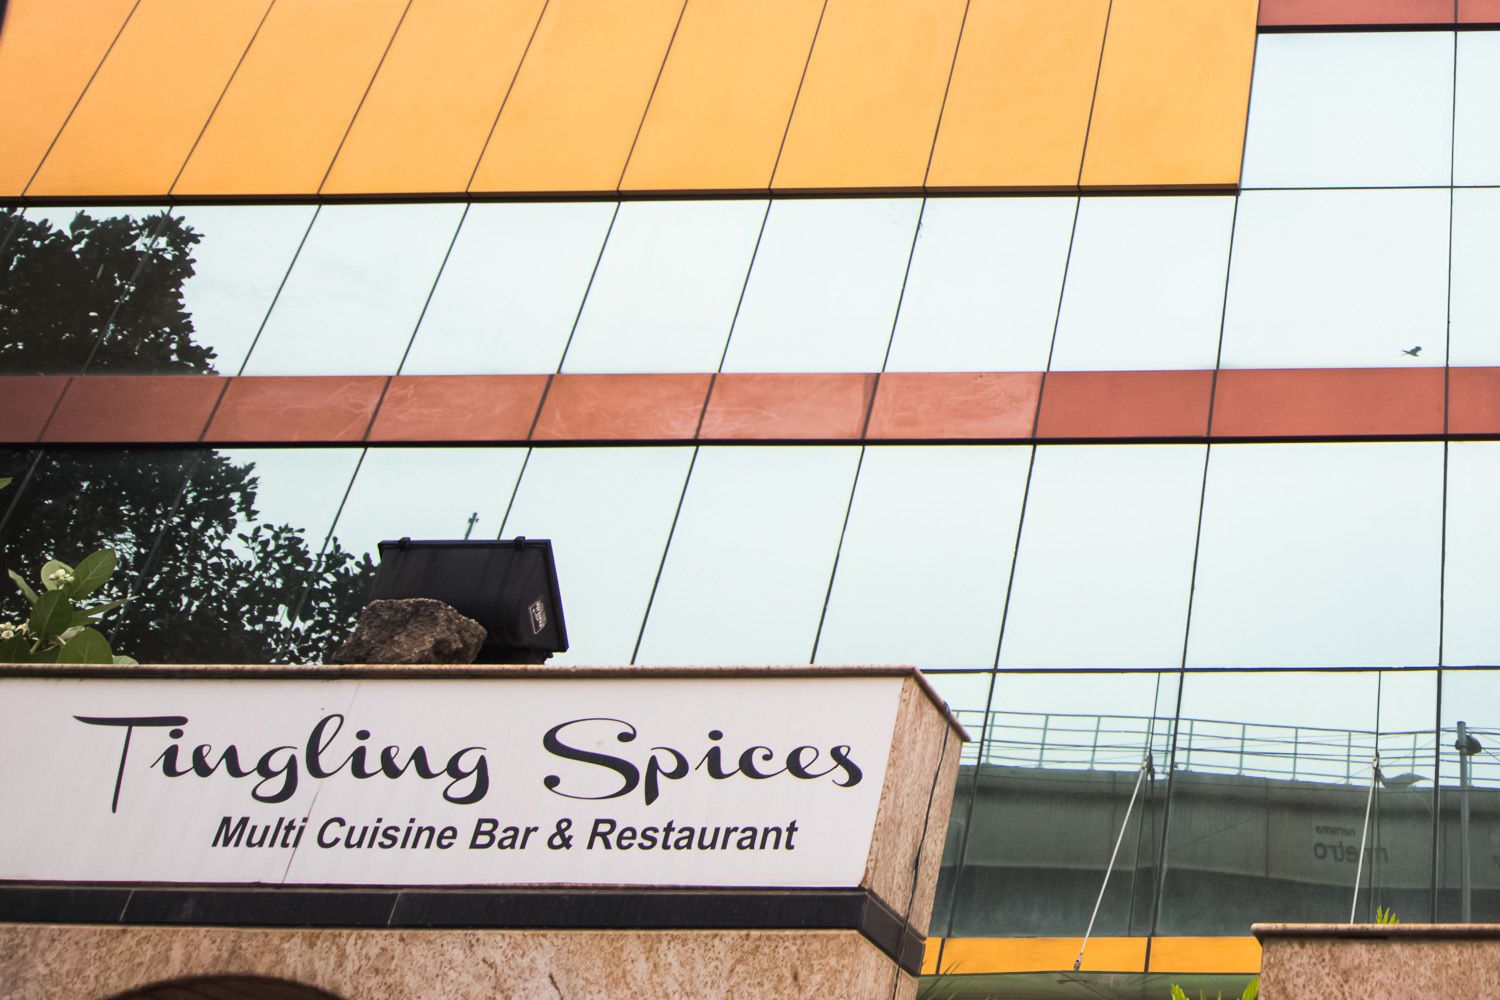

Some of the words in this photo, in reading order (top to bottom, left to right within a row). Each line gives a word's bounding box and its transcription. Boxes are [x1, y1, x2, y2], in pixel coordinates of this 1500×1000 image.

[73, 714, 490, 814] Tingling
[543, 717, 863, 806] Spices
[211, 816, 306, 849] Multi
[316, 816, 458, 850] Cuisine
[468, 818, 539, 850] Bar
[547, 818, 574, 850] &
[586, 818, 799, 851] Restaurant
